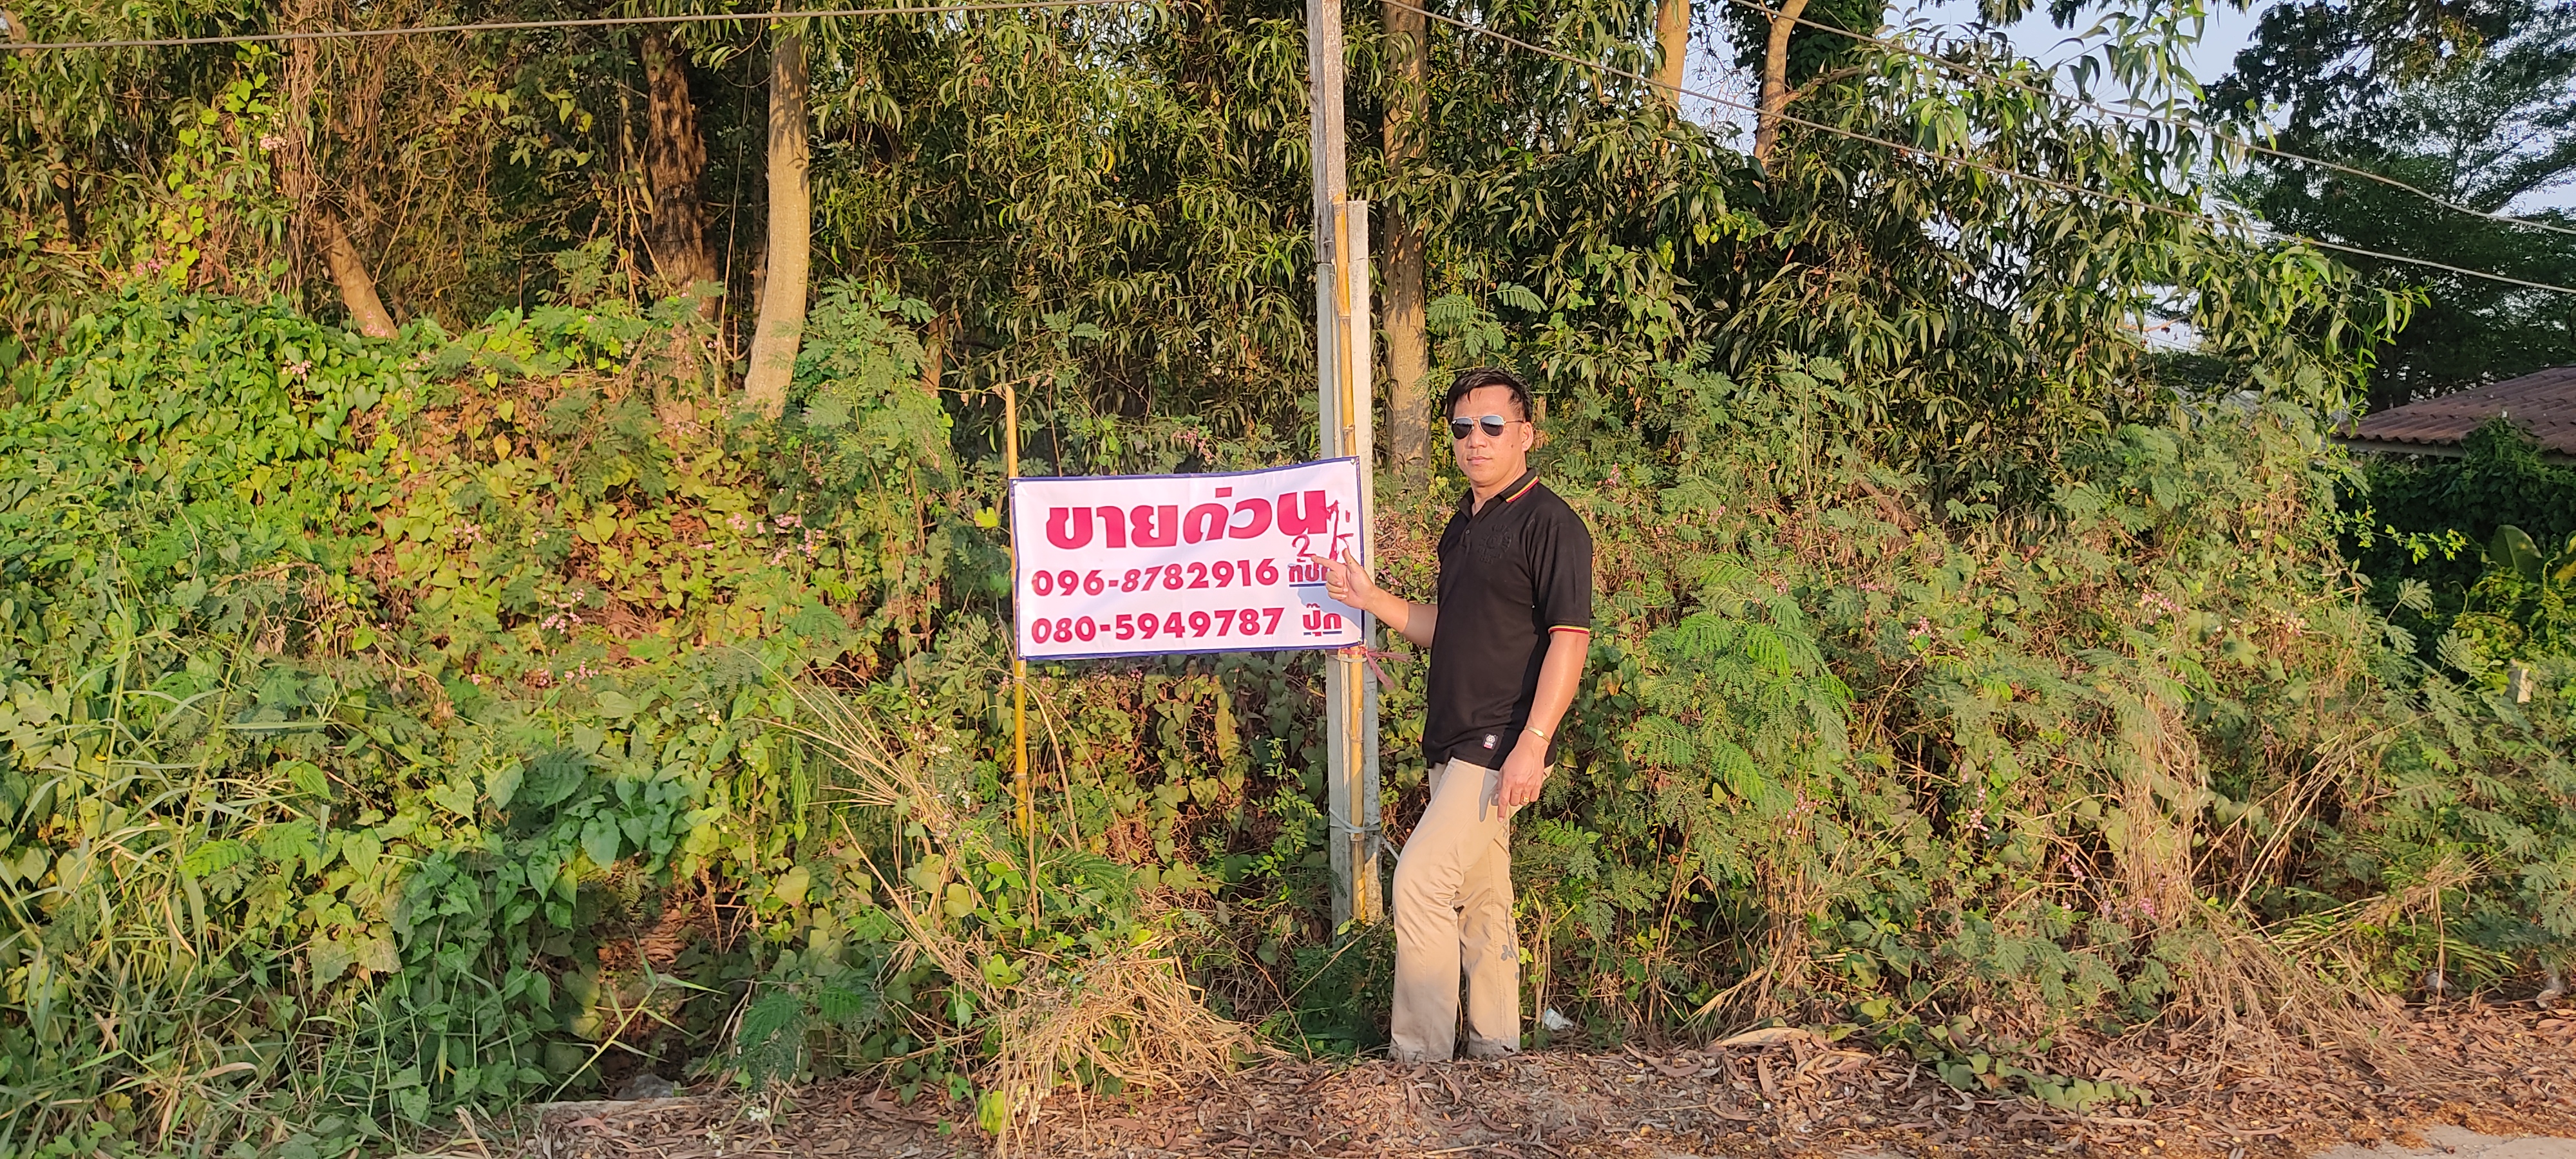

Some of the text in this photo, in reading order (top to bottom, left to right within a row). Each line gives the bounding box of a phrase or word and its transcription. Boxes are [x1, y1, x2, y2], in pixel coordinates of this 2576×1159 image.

[1046, 487, 1329, 549] ขายด่วน
[1292, 534, 1316, 558] 2
[1032, 558, 1279, 596] 096-8782916
[1032, 603, 1342, 644] 080-5949787 ปุ๊ก
